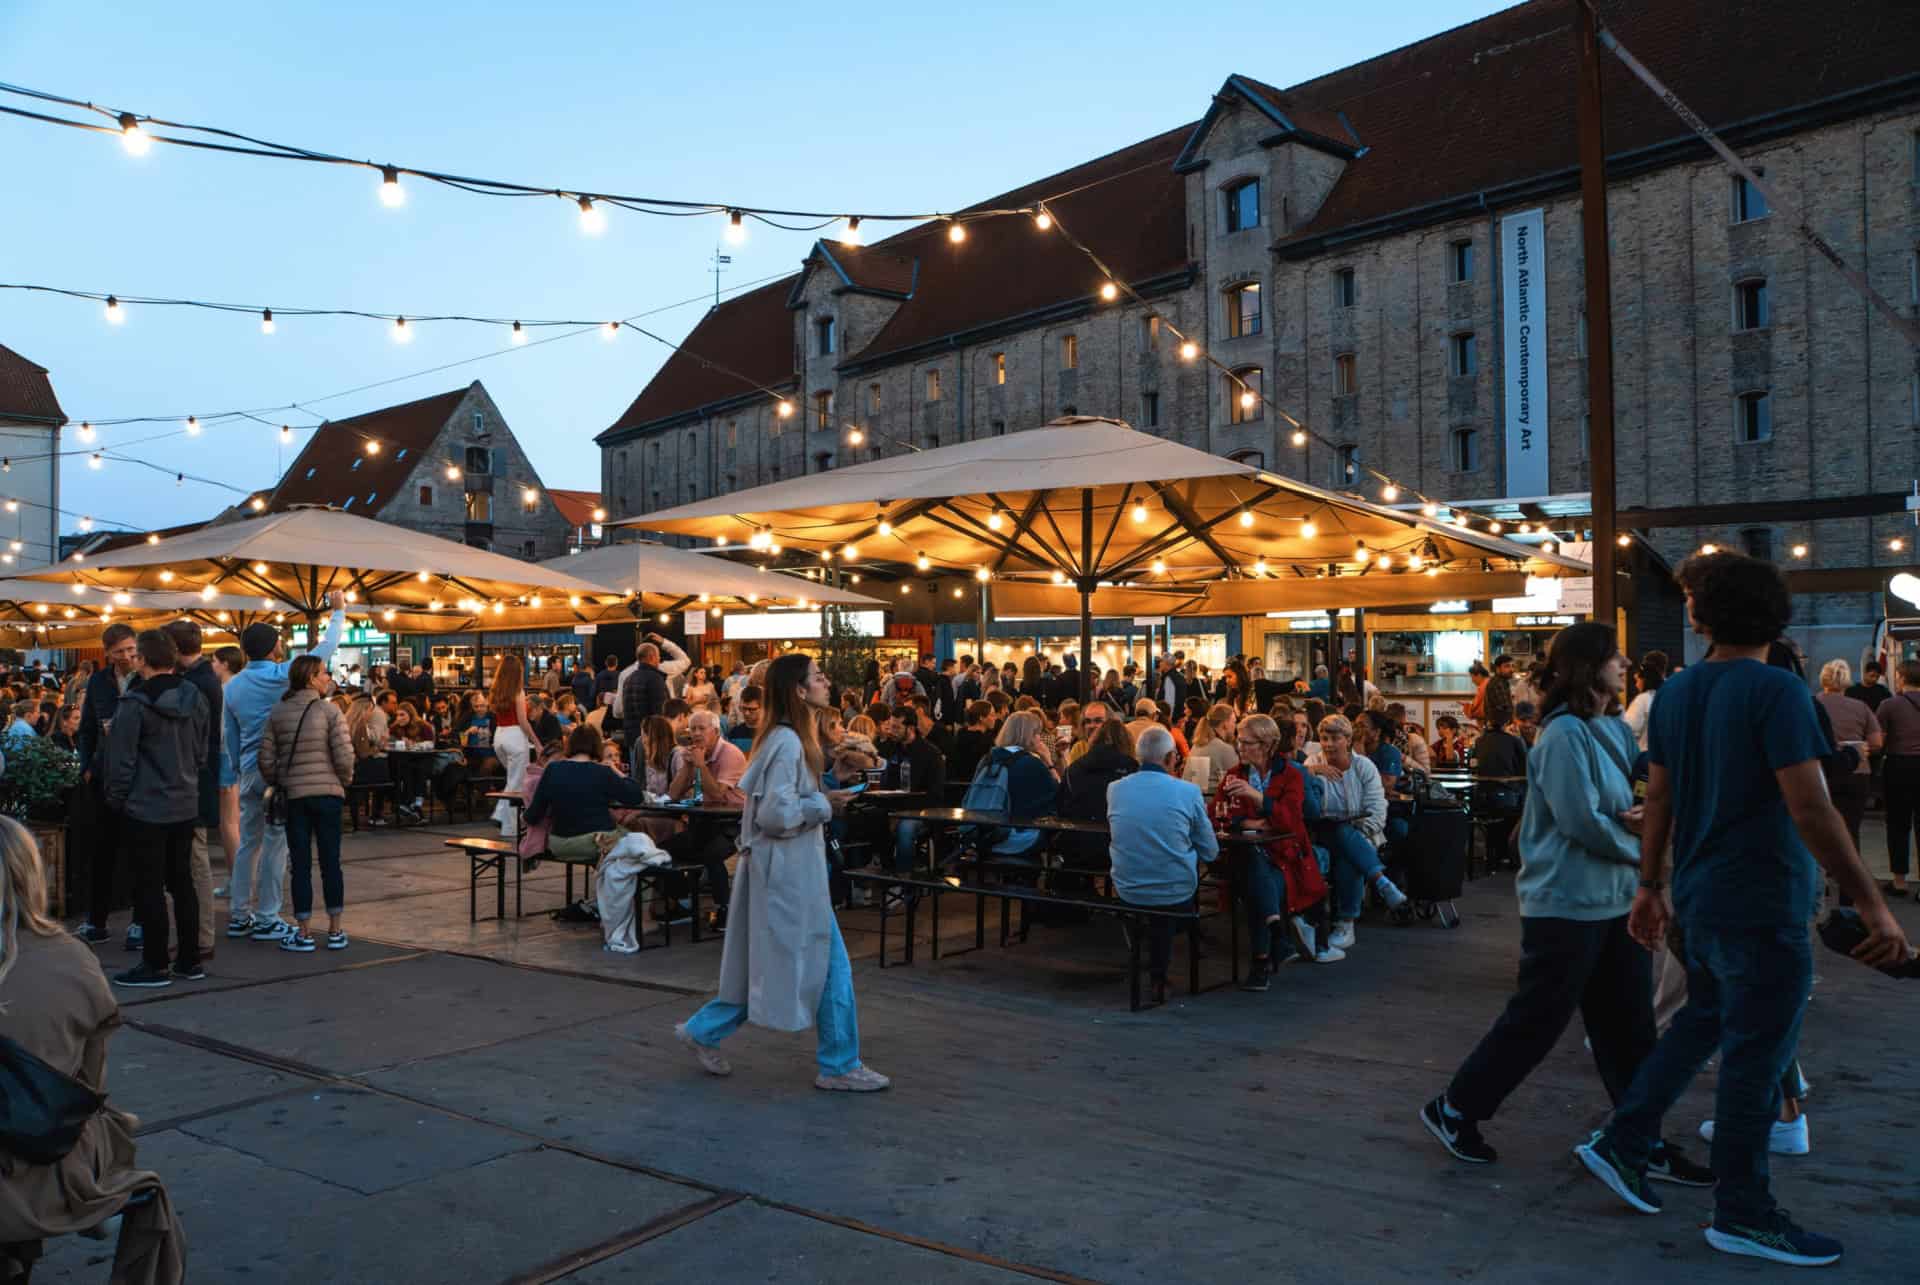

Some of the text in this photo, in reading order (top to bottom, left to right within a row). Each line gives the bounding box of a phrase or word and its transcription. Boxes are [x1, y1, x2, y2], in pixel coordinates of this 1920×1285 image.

[1517, 226, 1532, 450] North Atlantic Contemporary Art
